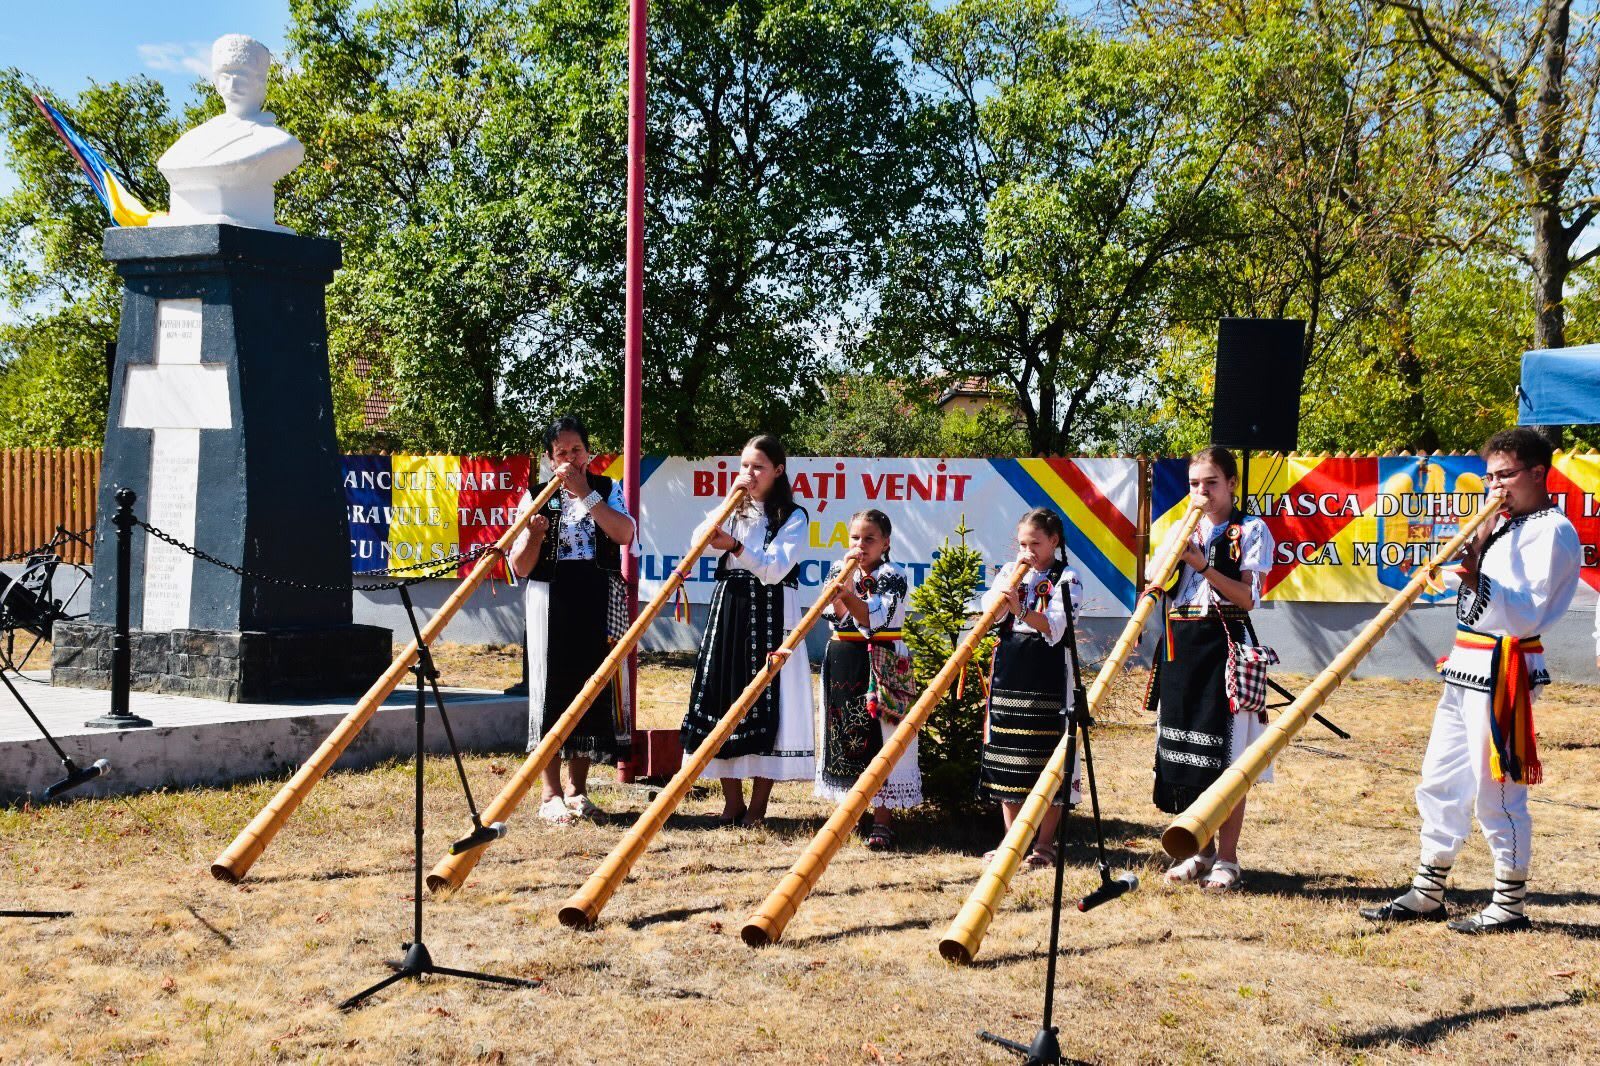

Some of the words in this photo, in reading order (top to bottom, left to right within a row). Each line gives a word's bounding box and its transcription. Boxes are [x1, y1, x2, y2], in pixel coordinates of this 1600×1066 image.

[445, 472, 522, 492] MARE,
[346, 505, 450, 529] RAVULE,
[380, 541, 423, 560] NOI
